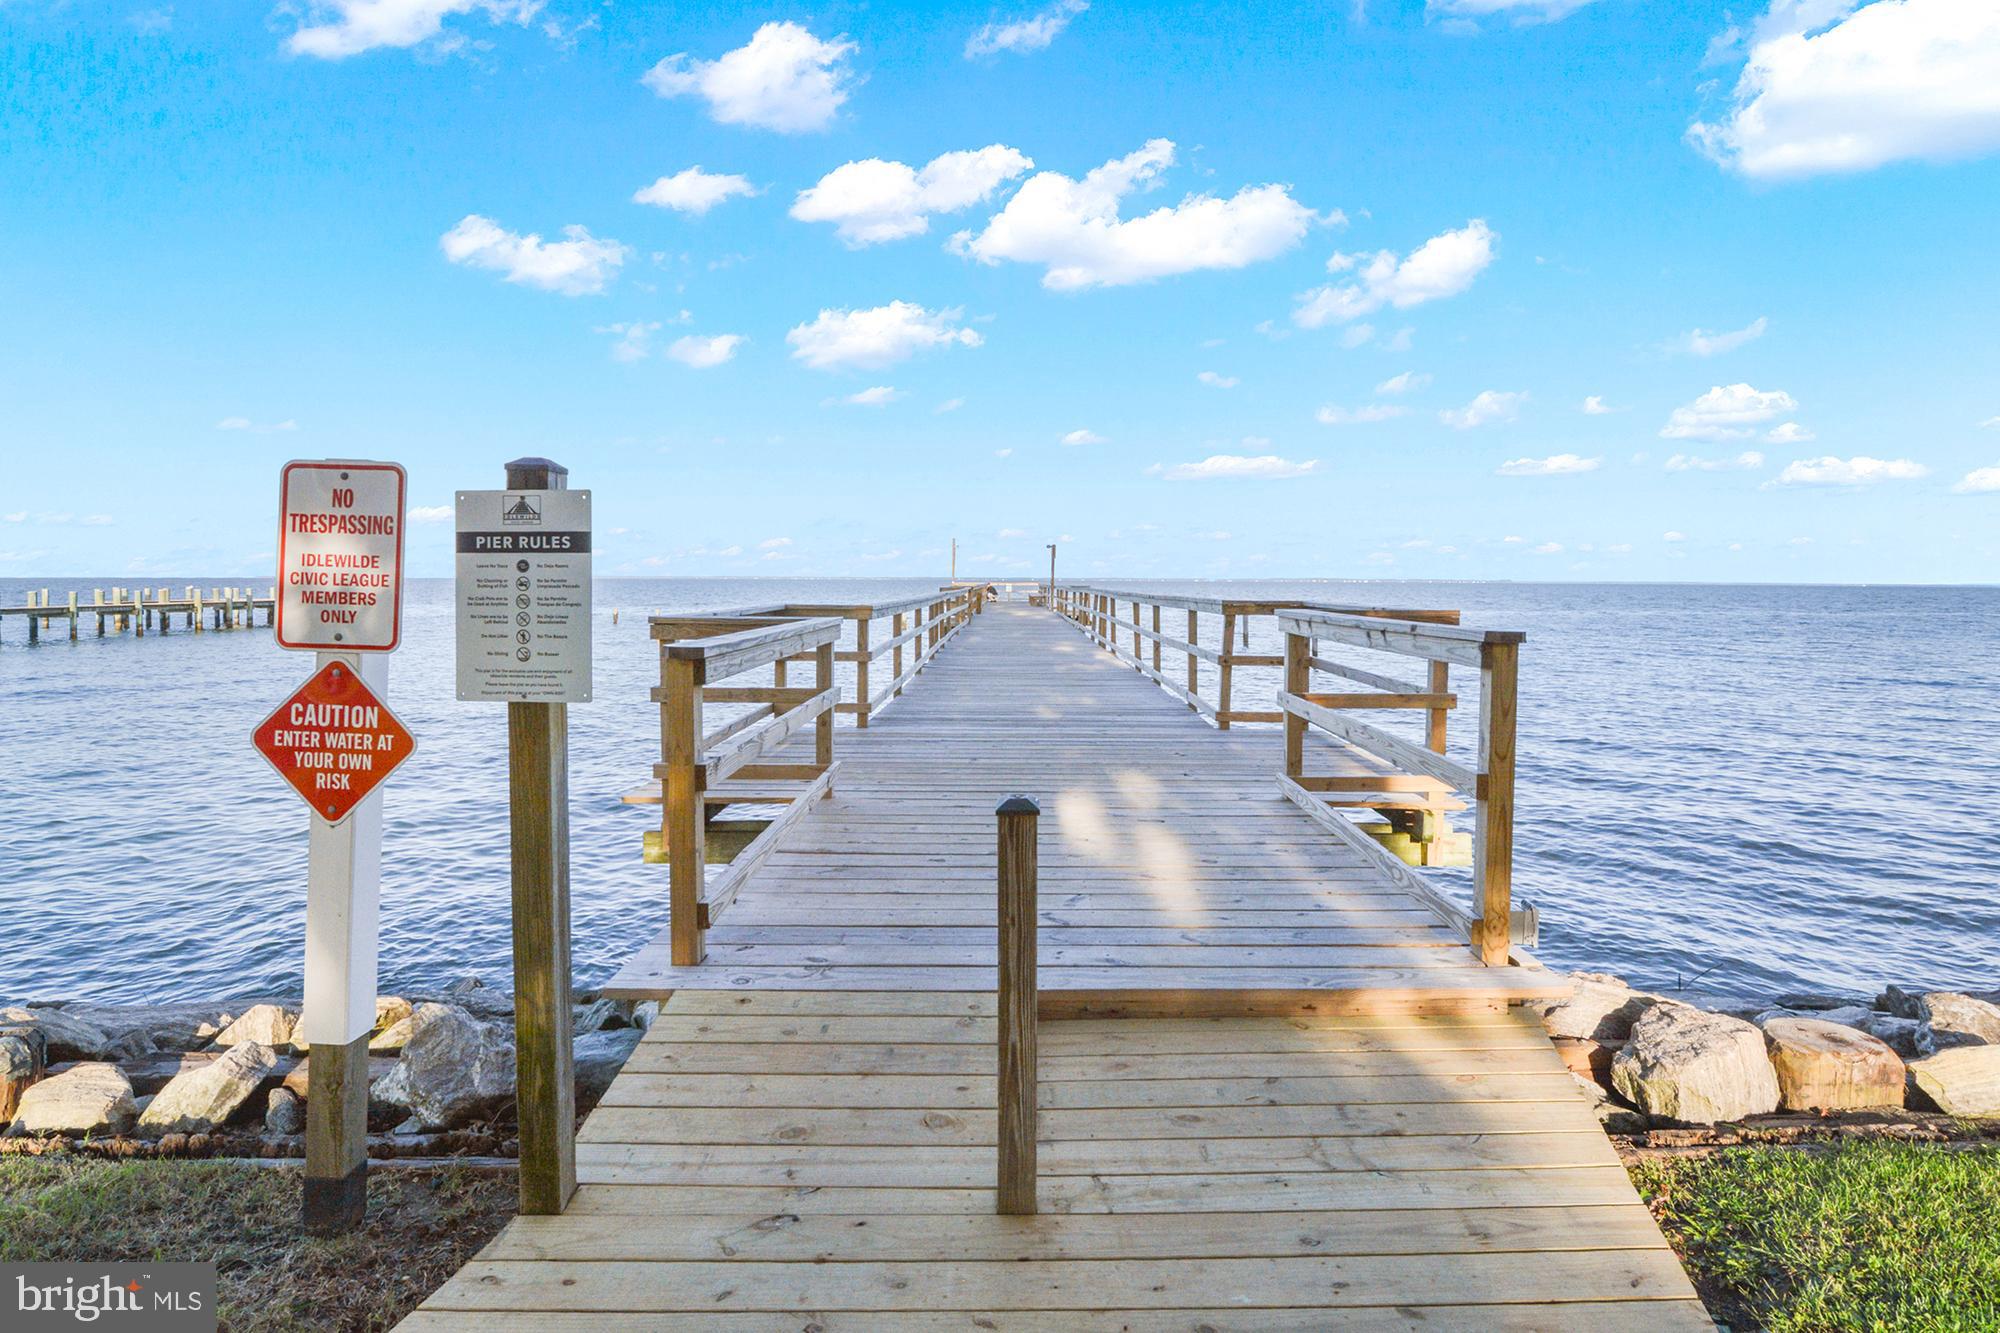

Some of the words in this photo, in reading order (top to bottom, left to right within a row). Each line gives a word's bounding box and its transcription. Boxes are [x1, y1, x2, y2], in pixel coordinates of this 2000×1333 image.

[332, 488, 354, 508] NO
[290, 513, 394, 535] TRESPASSING
[476, 536, 513, 549] PIER
[519, 536, 571, 549] RULES
[301, 553, 380, 569] IDLEWILDE
[290, 572, 328, 586] CIVIC
[333, 573, 390, 588] LEAGUE
[301, 591, 376, 606] MEMBERS
[320, 610, 357, 624] ONLY
[290, 703, 378, 728] CAUTION
[274, 730, 320, 748] ENTER
[324, 732, 372, 750] WATER
[377, 735, 394, 750] AT
[294, 752, 334, 769] YOUR
[338, 753, 372, 770] OWN
[316, 772, 350, 790] RISK
